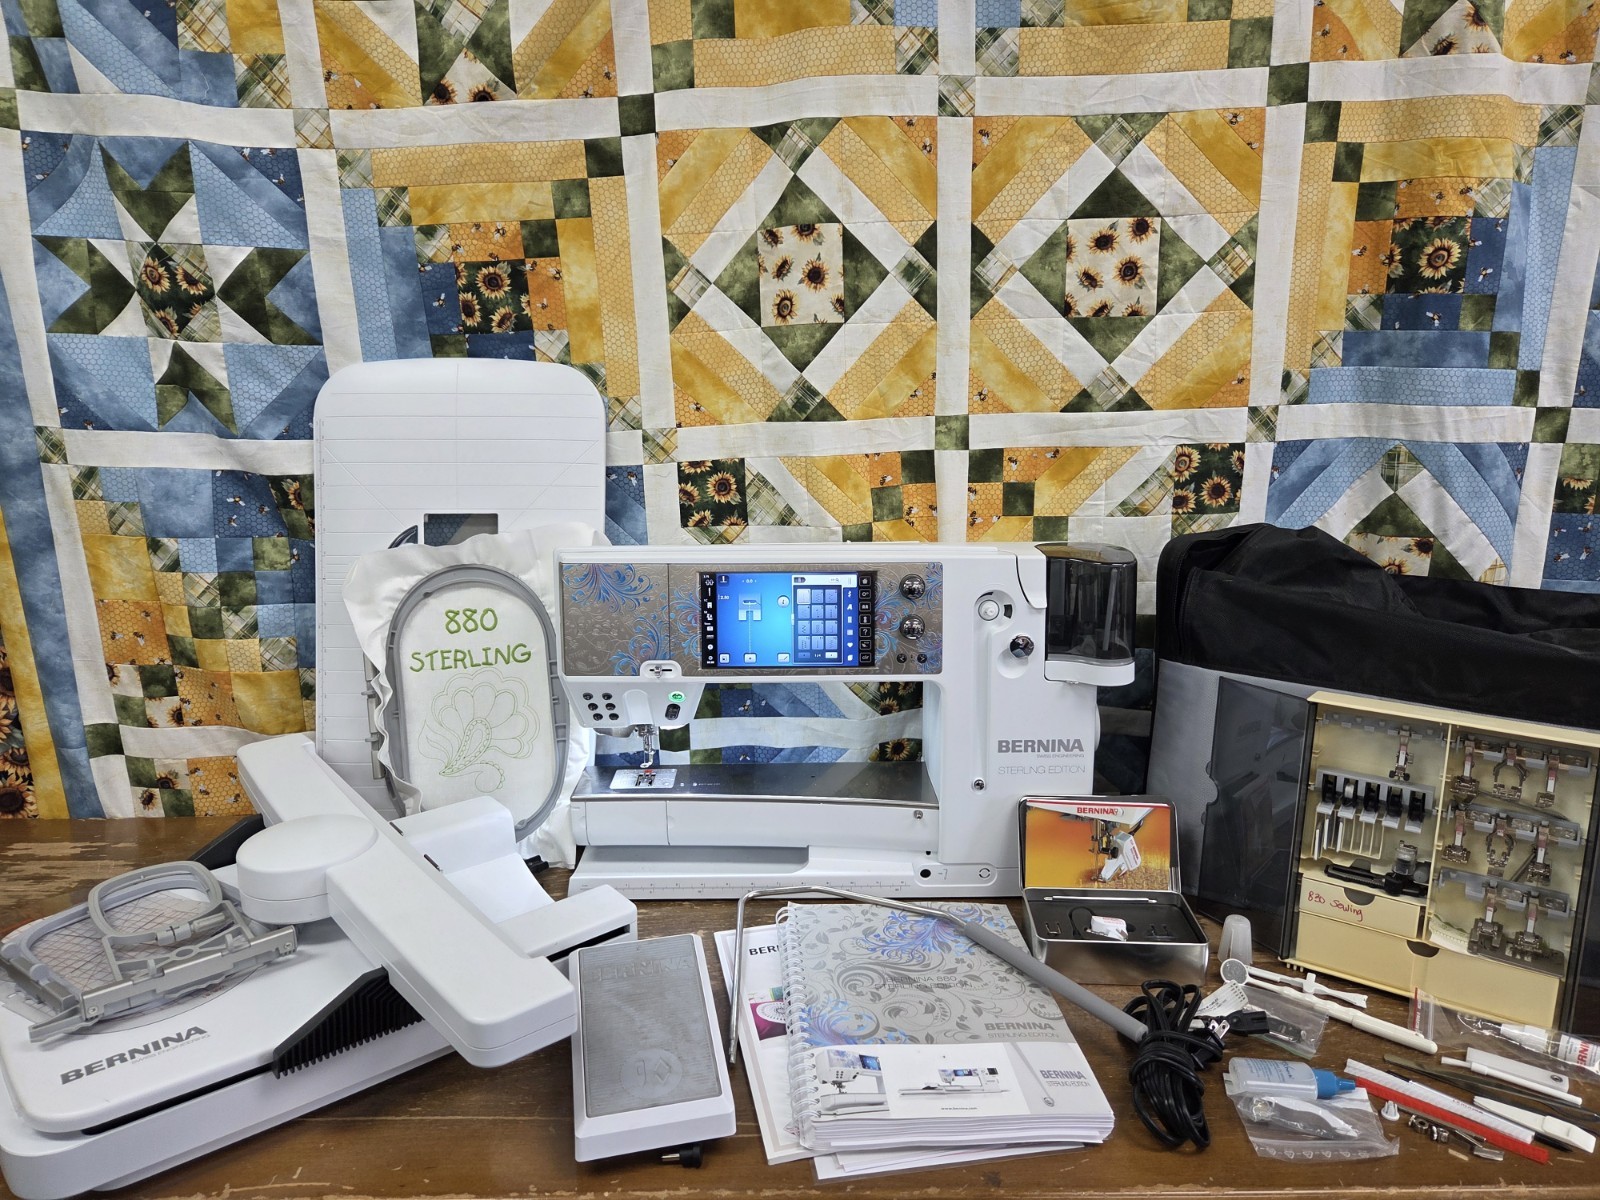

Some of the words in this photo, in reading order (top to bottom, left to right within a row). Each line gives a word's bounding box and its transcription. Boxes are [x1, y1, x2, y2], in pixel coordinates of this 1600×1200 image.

[444, 607, 498, 634] 880
[409, 643, 532, 672] STERLING
[997, 738, 1085, 753] BERNINA
[998, 766, 1046, 775] STERLING
[1048, 765, 1086, 774] EDITION
[1076, 806, 1116, 816] BERNINA
[885, 974, 934, 982] BERNINA
[984, 1022, 1056, 1031] BERNINA
[60, 1026, 208, 1085] BERNINA
[1040, 1069, 1087, 1080] BERNINA
